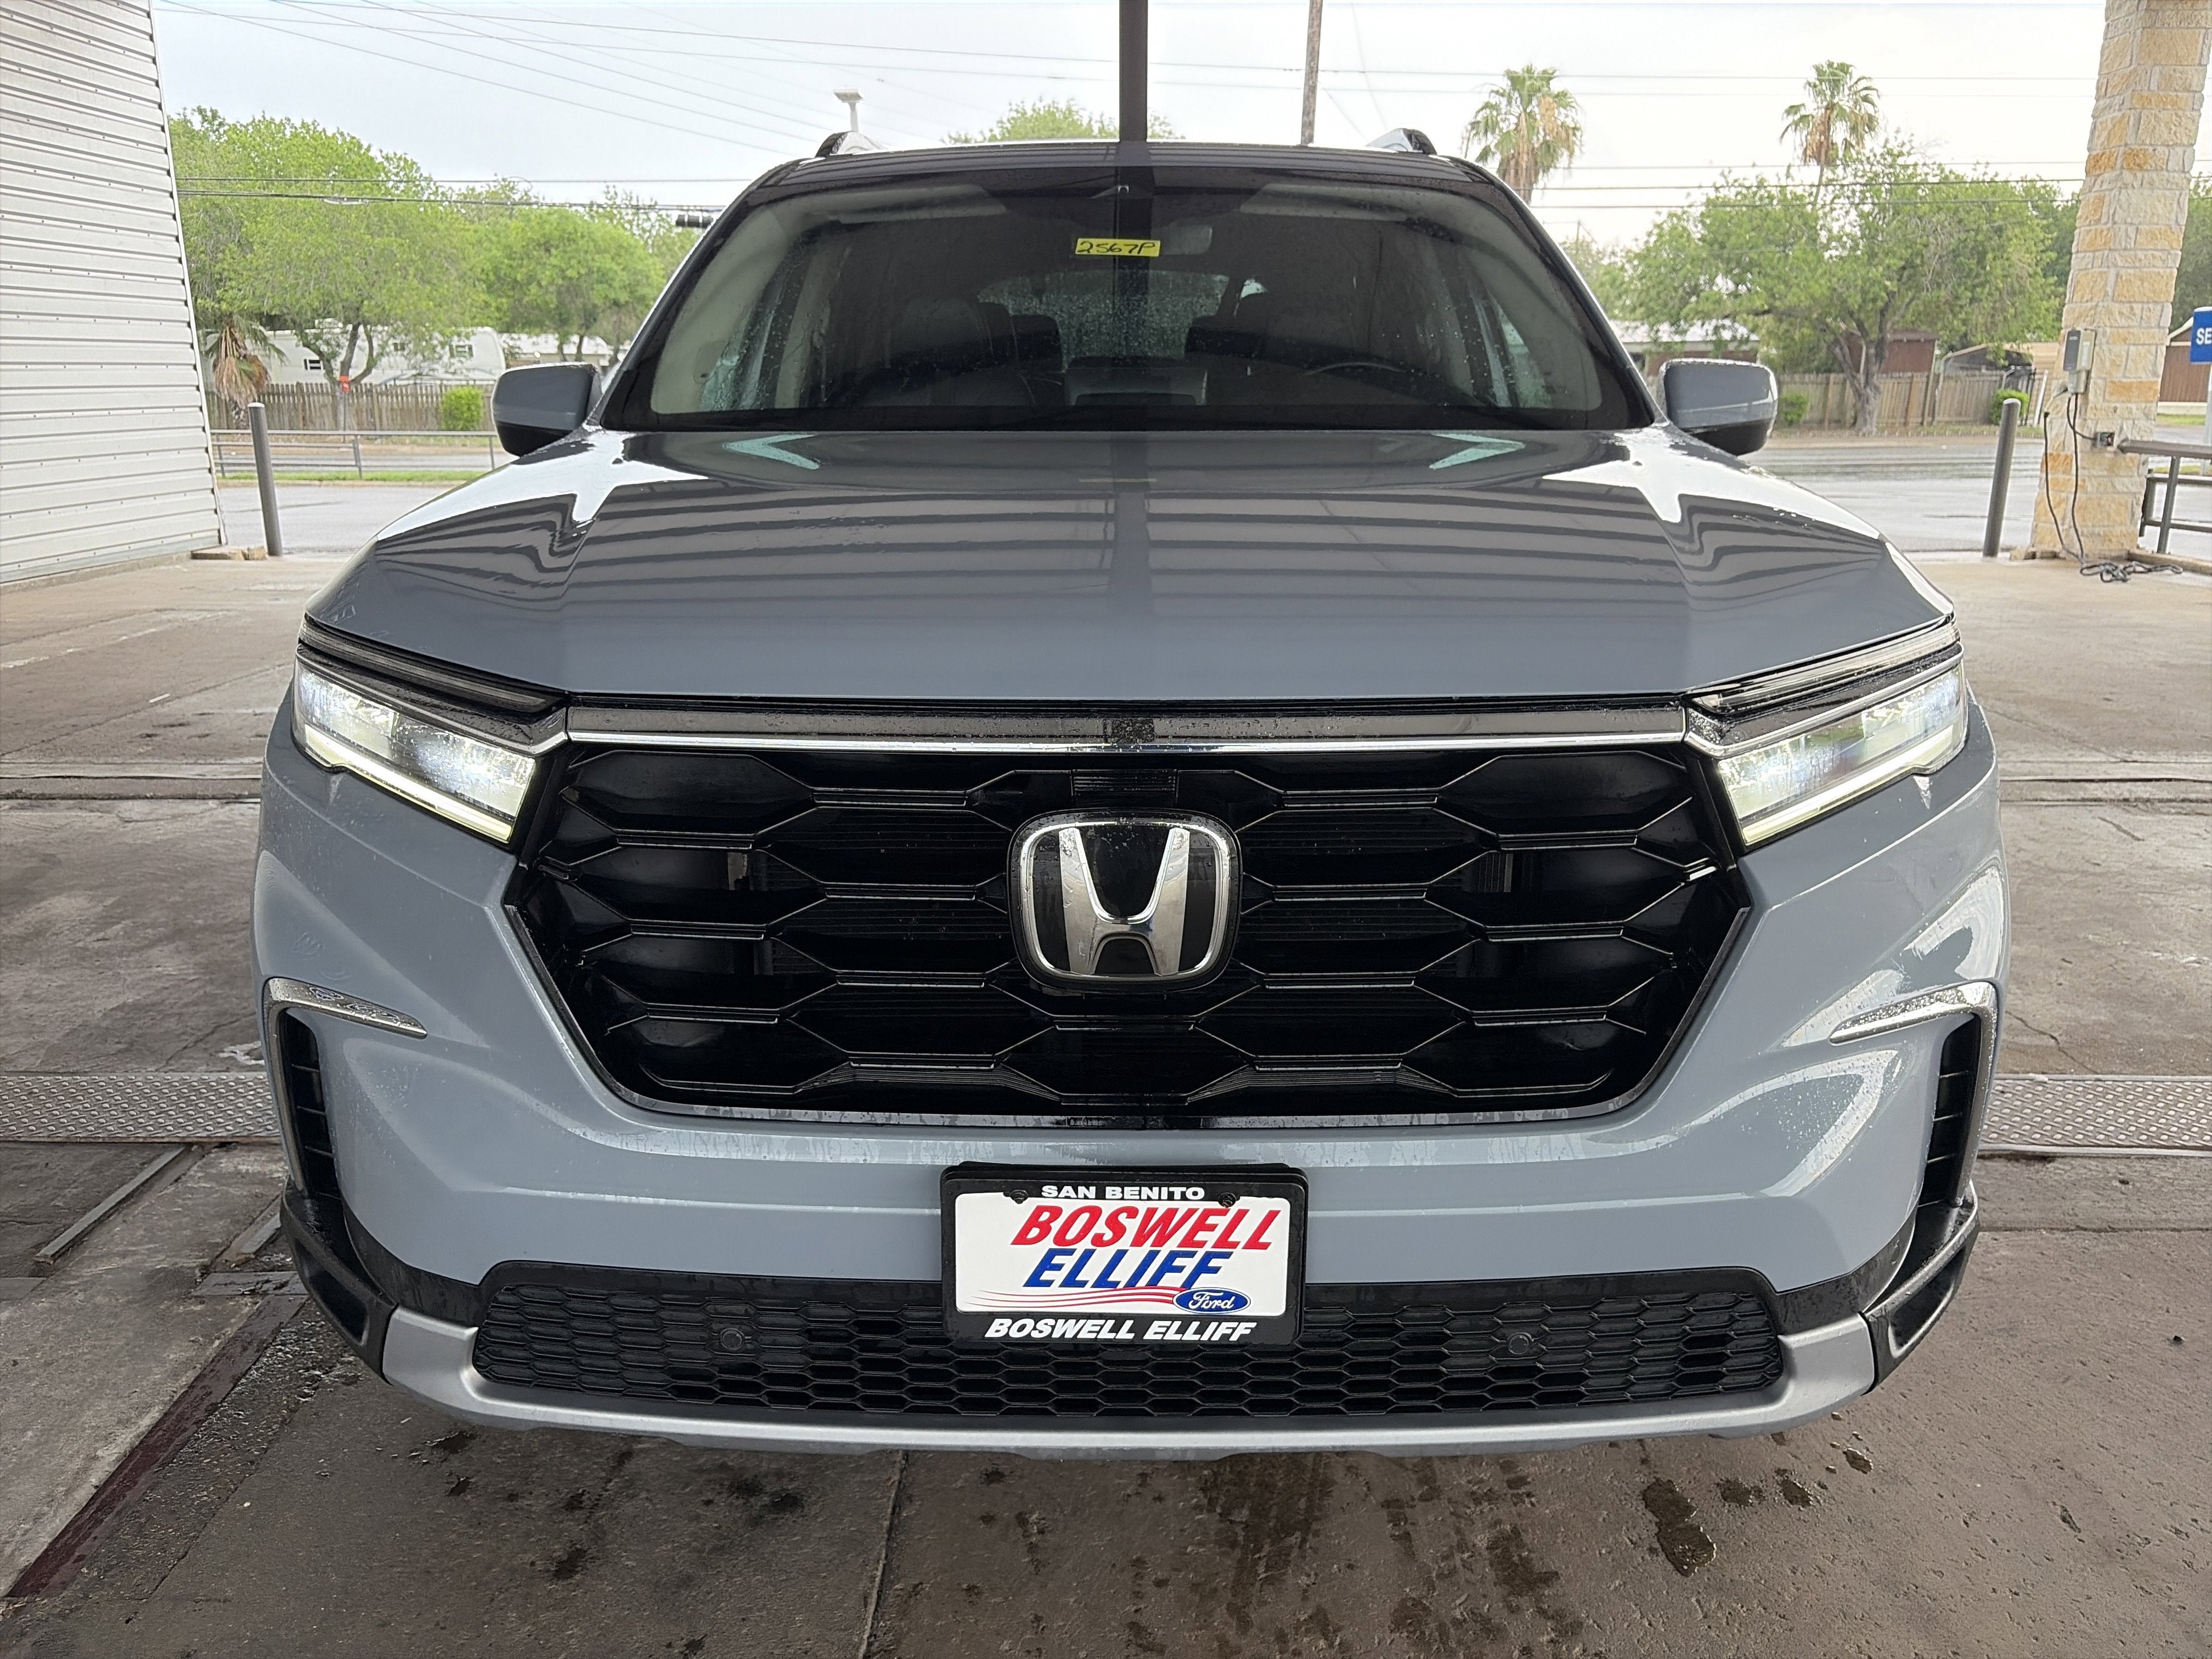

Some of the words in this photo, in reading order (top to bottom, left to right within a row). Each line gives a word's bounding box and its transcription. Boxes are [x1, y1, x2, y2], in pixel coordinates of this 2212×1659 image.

[1077, 241, 1155, 254] 2567P
[1041, 1186, 1096, 1199] SAN
[1105, 1186, 1205, 1200] BENITO
[1010, 1205, 1282, 1250] BOSWELL
[1022, 1248, 1234, 1289] ELLIFF
[1188, 1291, 1235, 1309] Ford
[984, 1318, 1135, 1339] BOSWELL
[1143, 1320, 1257, 1341] ELLIFF
